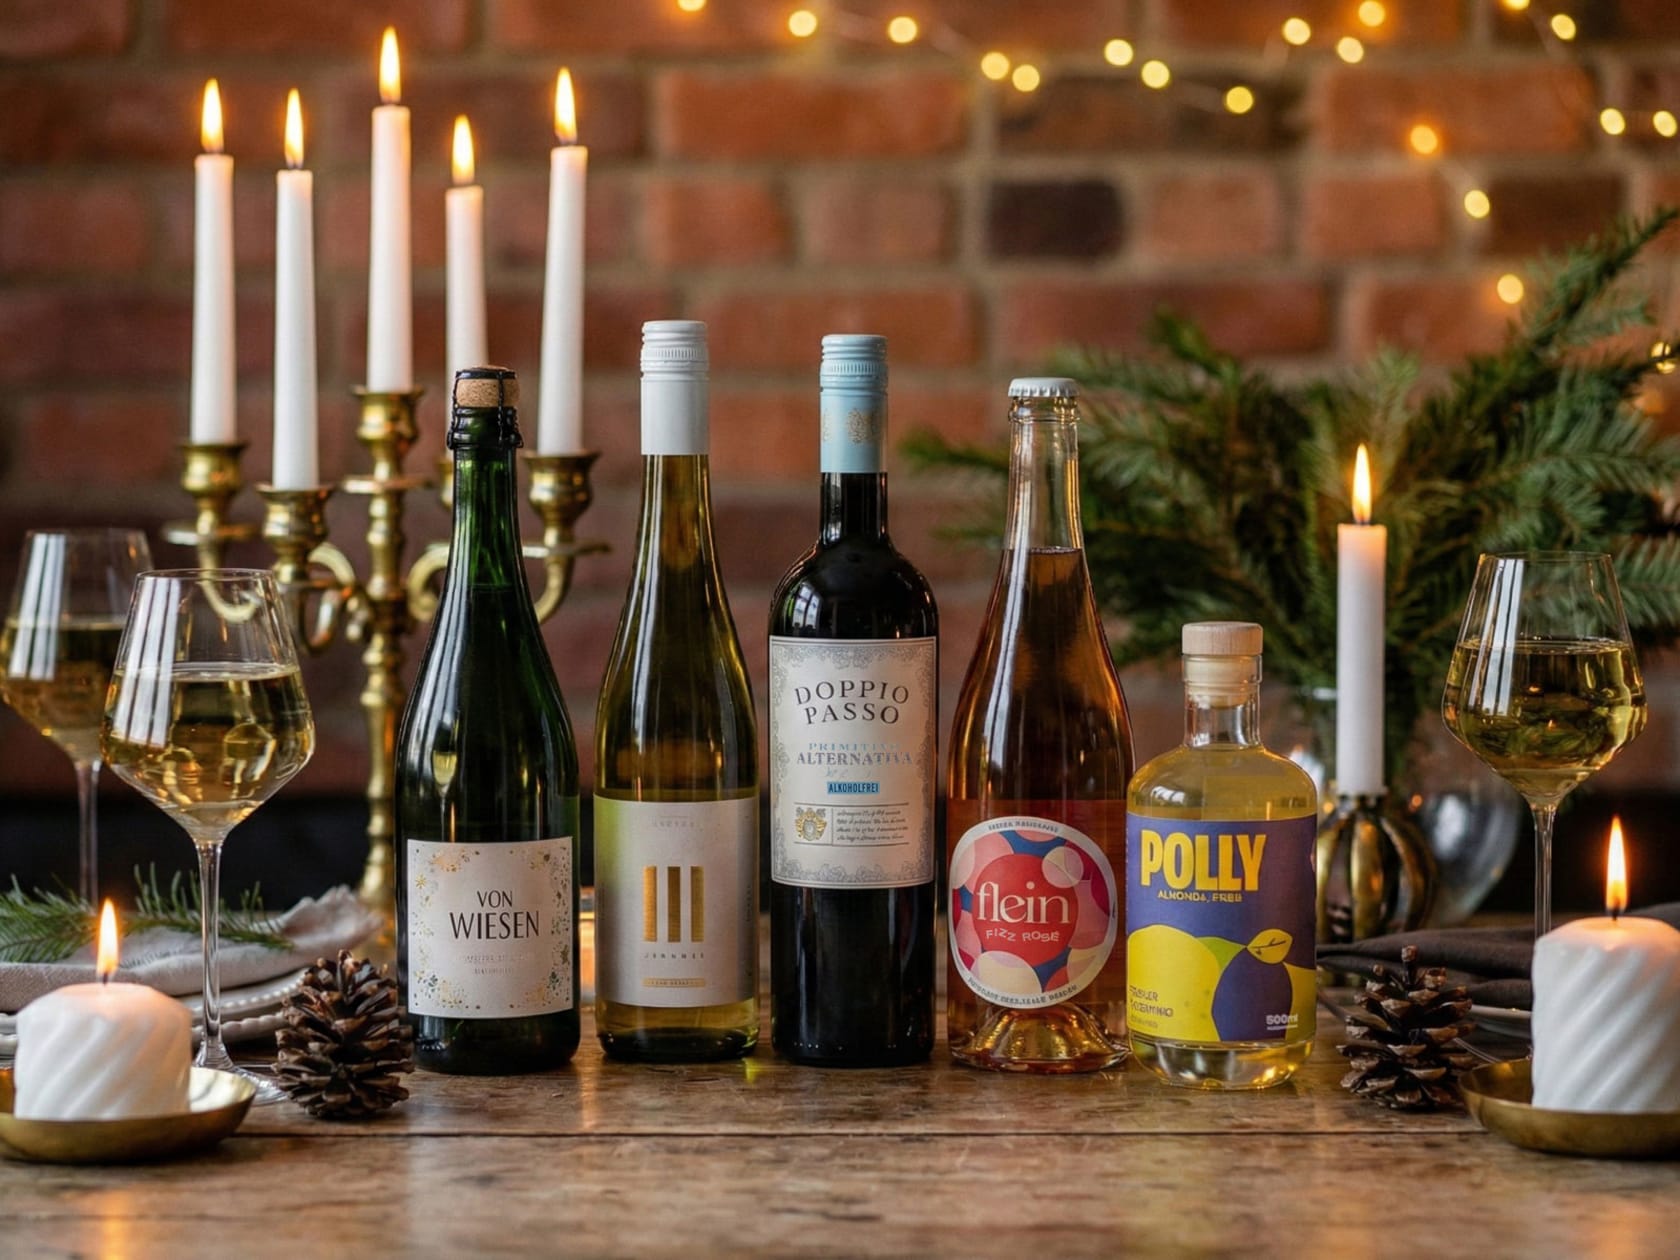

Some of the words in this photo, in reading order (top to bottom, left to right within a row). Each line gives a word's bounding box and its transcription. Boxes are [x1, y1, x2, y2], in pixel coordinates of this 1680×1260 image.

[795, 680, 909, 705] DOPPIO
[804, 702, 899, 725] PASSO
[828, 783, 879, 793] ALKOHOLFREI
[1141, 829, 1266, 891] POLLY
[477, 890, 513, 908] VON
[976, 881, 1071, 924] flein
[450, 911, 540, 940] WIESEN
[985, 928, 1017, 942] FIZZ
